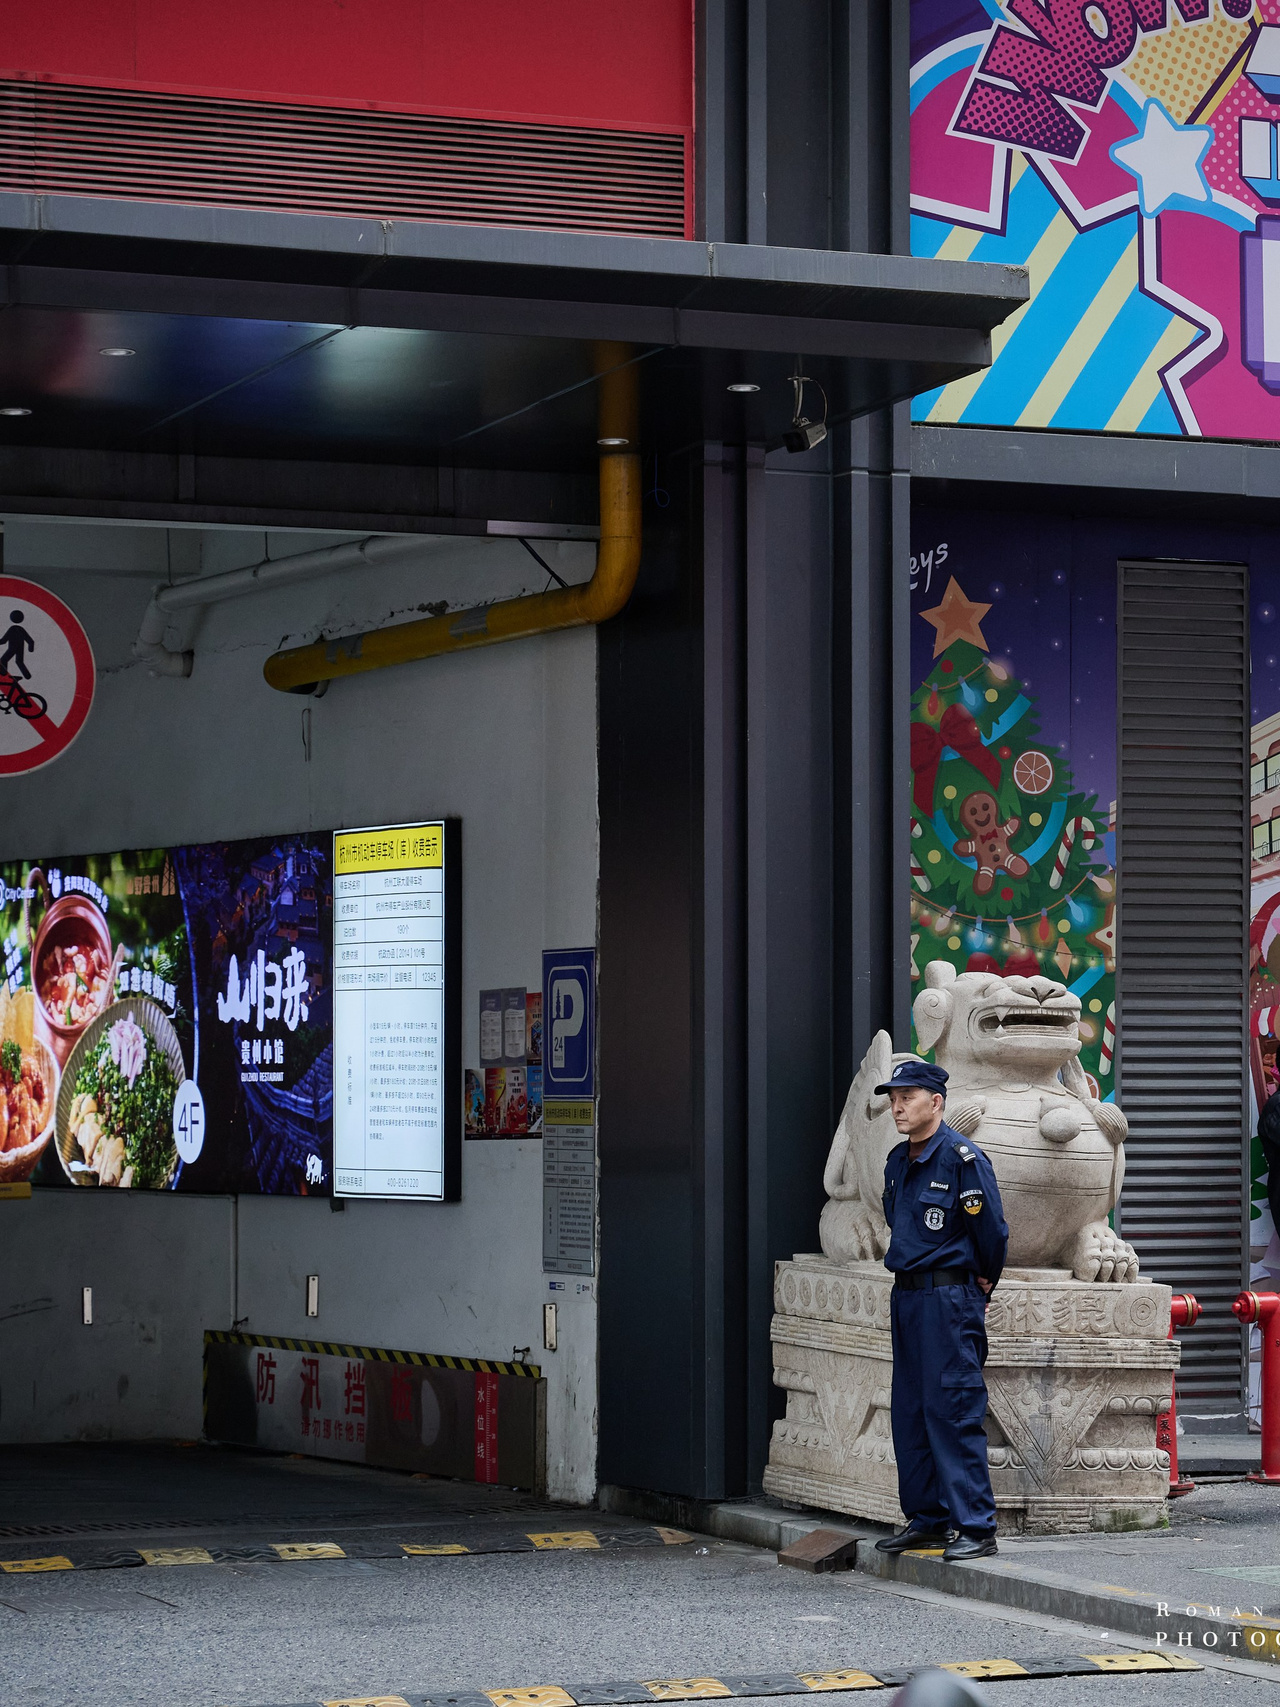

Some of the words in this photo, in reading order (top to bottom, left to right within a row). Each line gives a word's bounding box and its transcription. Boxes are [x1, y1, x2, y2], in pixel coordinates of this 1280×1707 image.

[241, 1039, 284, 1064] 贵州小馆
[177, 1101, 200, 1143] 4F
[256, 1352, 414, 1422] 防汛挡板
[300, 1416, 366, 1444] 请勿挪作他用
